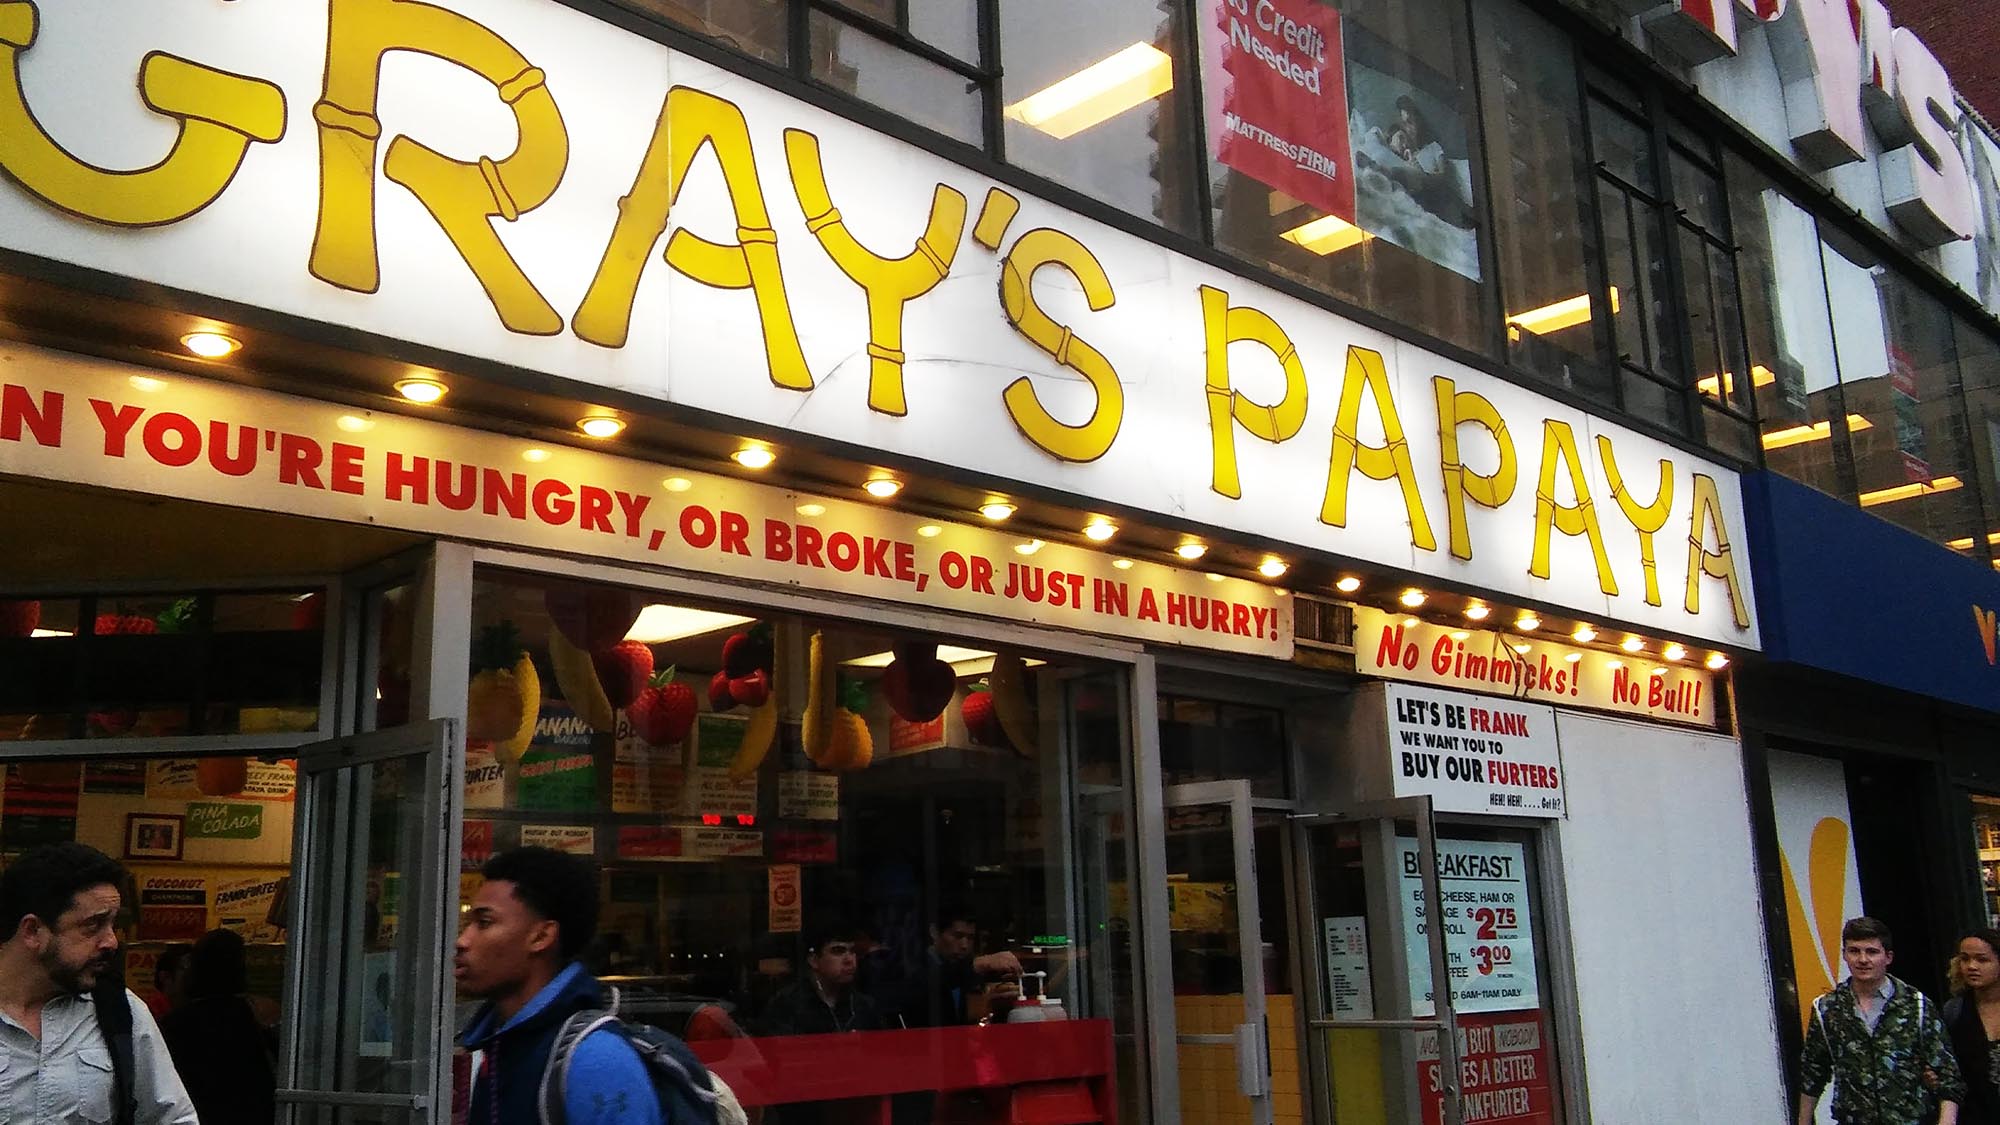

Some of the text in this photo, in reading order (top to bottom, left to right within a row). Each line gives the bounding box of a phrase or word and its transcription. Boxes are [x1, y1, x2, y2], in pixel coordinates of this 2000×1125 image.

[1256, 0, 1324, 63] Credit
[1231, 16, 1321, 95] Needed
[0, 0, 1750, 629] GRAY'S PAPAYA
[0, 384, 1279, 641] N YOU'RE HUNGRY, OR BROKE, OR JUST IN A HURRY!
[1376, 625, 1703, 718] No Gimmicks! No Bull!
[535, 716, 594, 737] ANAN
[1396, 698, 1529, 738] LET'S BE FRANK
[1400, 730, 1504, 755] WE WANT YOU TO
[1402, 752, 1559, 789] BUY OUR FURTERS
[1490, 793, 1506, 806] HEH!
[202, 813, 260, 834] COLADA
[1404, 851, 1513, 878] BAKFAST
[147, 878, 205, 888] COCONUT
[1480, 892, 1499, 904] HAM
[1502, 893, 1515, 903] OR
[1461, 988, 1500, 1000] 6AM-11AM
[1501, 988, 1522, 998] DAILY
[1469, 1026, 1535, 1054] BUT NOBODY
[1481, 1059, 1492, 1086] A
[1493, 1054, 1537, 1084] BETTER
[1438, 1087, 1530, 1125] FNKFURTER
